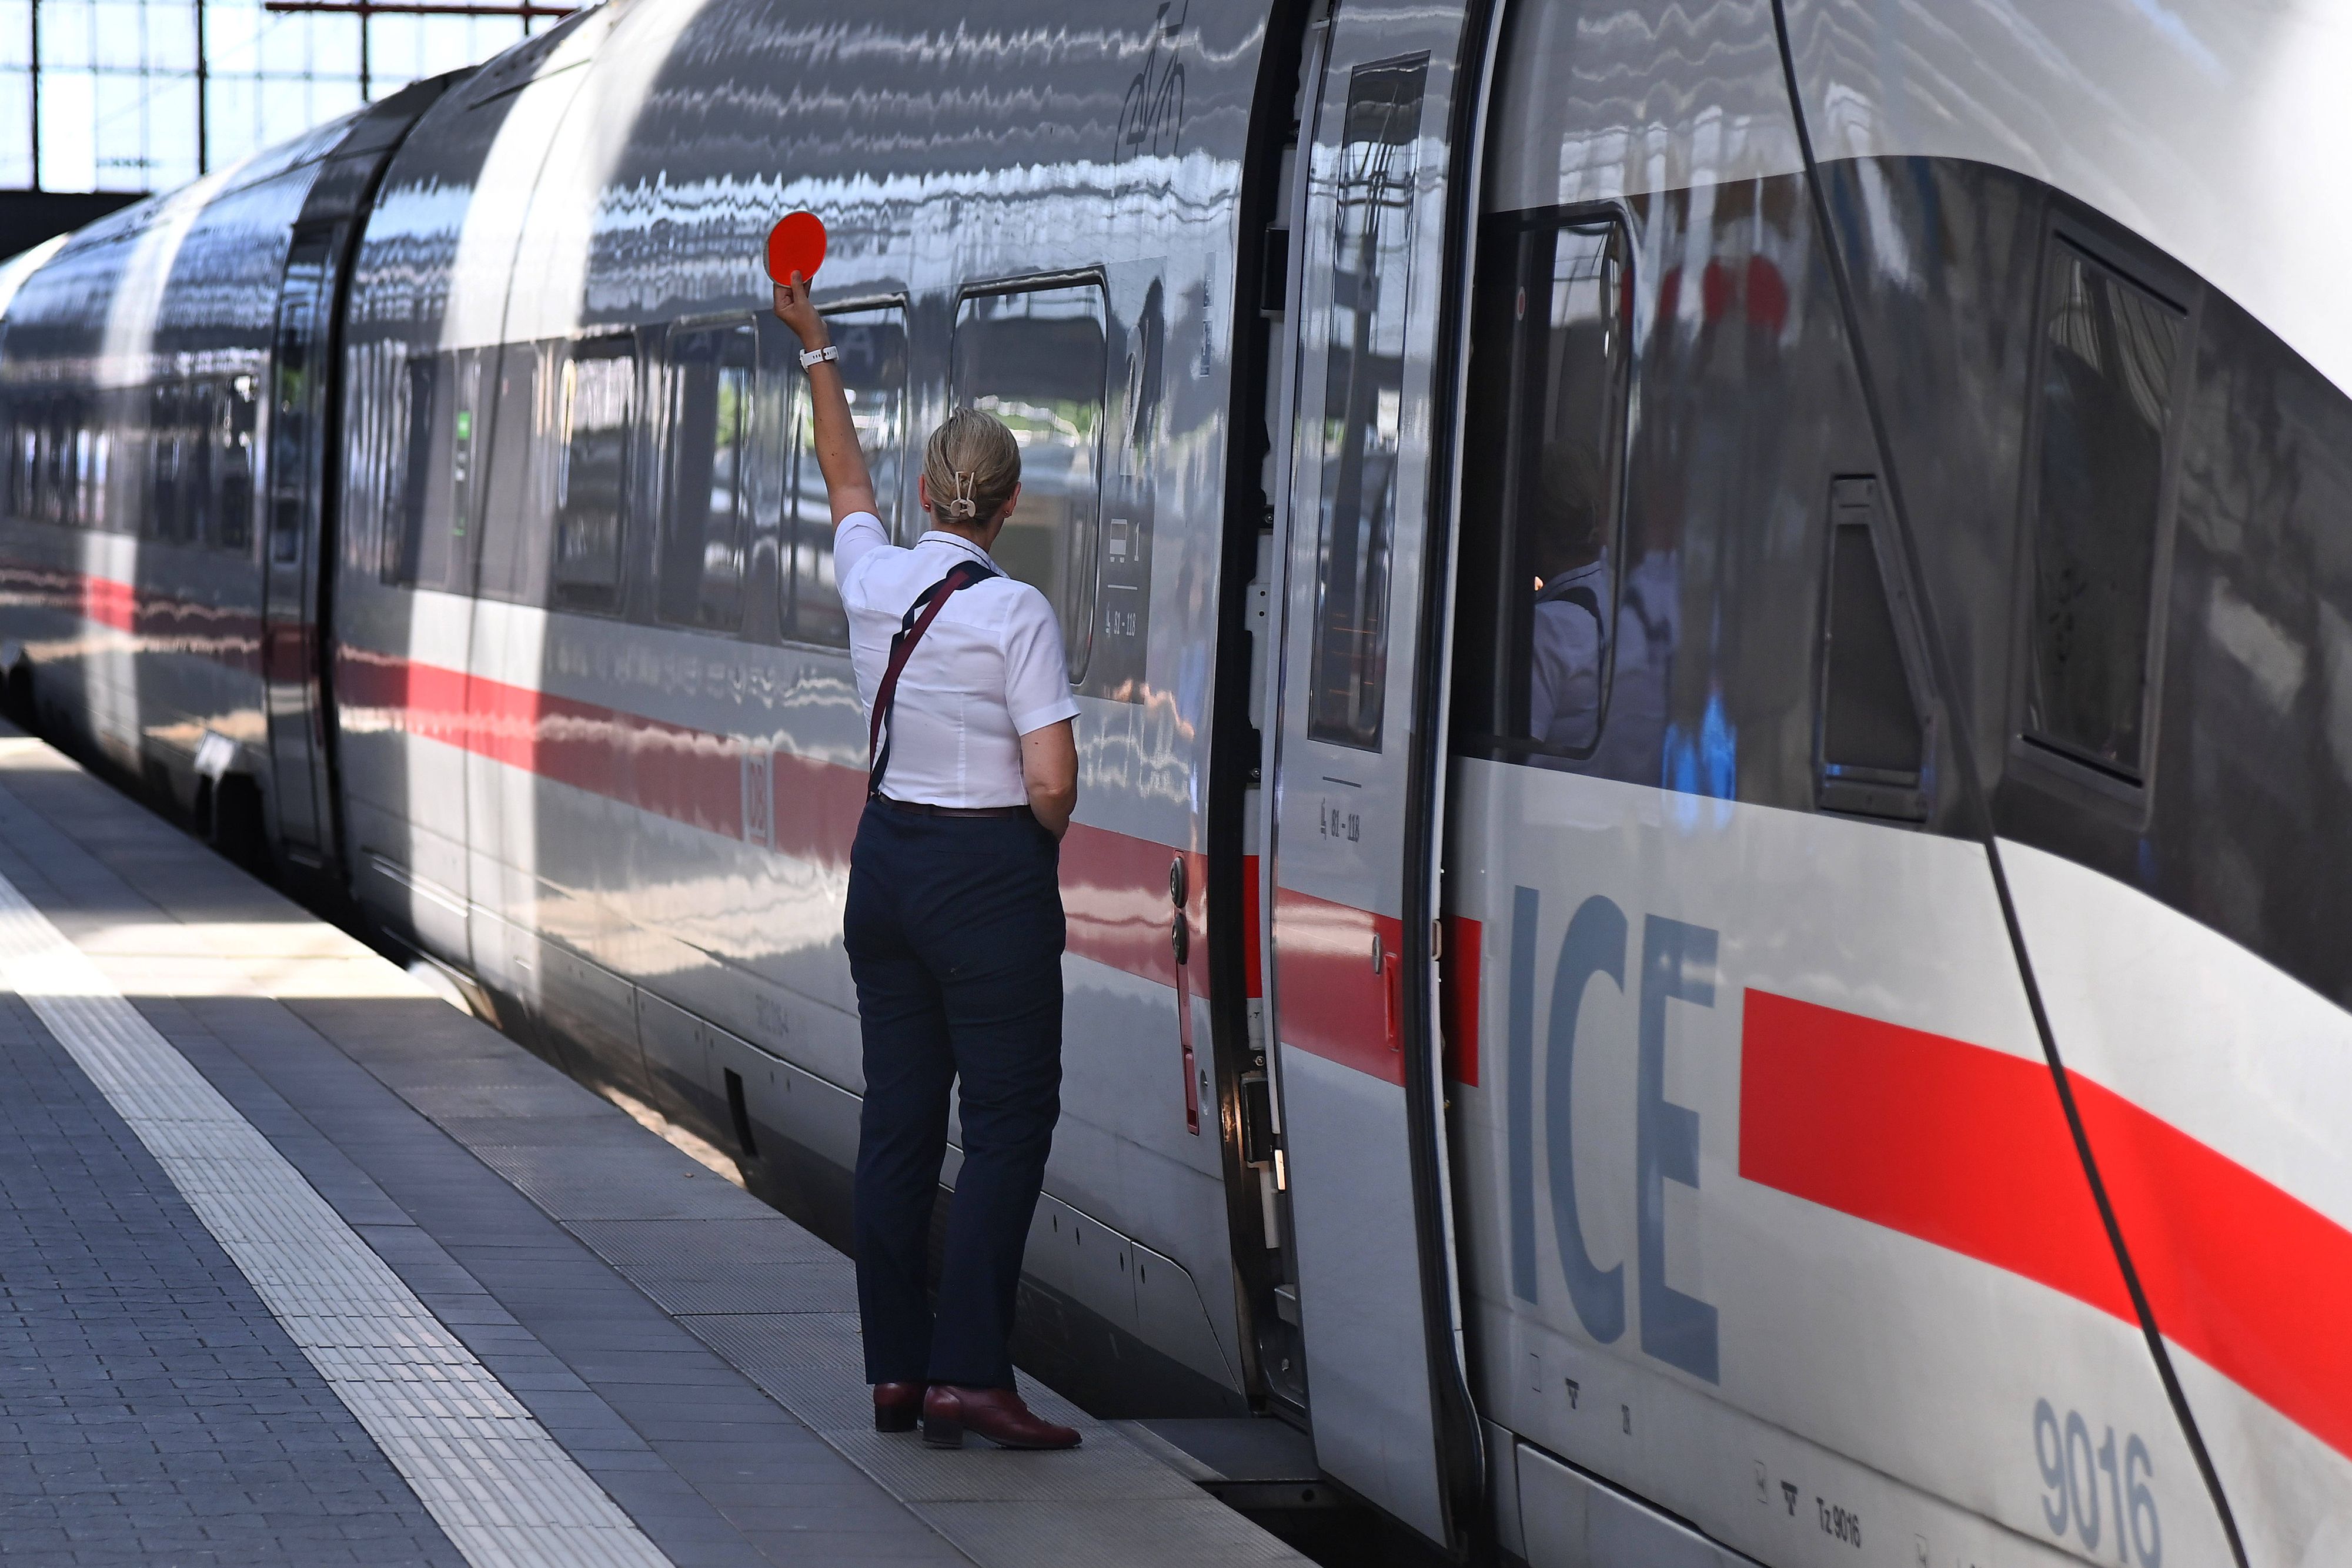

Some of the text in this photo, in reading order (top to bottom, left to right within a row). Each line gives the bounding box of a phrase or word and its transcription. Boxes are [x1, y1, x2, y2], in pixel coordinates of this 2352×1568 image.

[1126, 613, 1136, 637] 118
[1331, 809, 1339, 837] 81
[1348, 814, 1359, 842] 118
[1508, 885, 1719, 1386] ICE
[2034, 1398, 2161, 1568] 9016
[1816, 1497, 1861, 1548] Tz 9016
